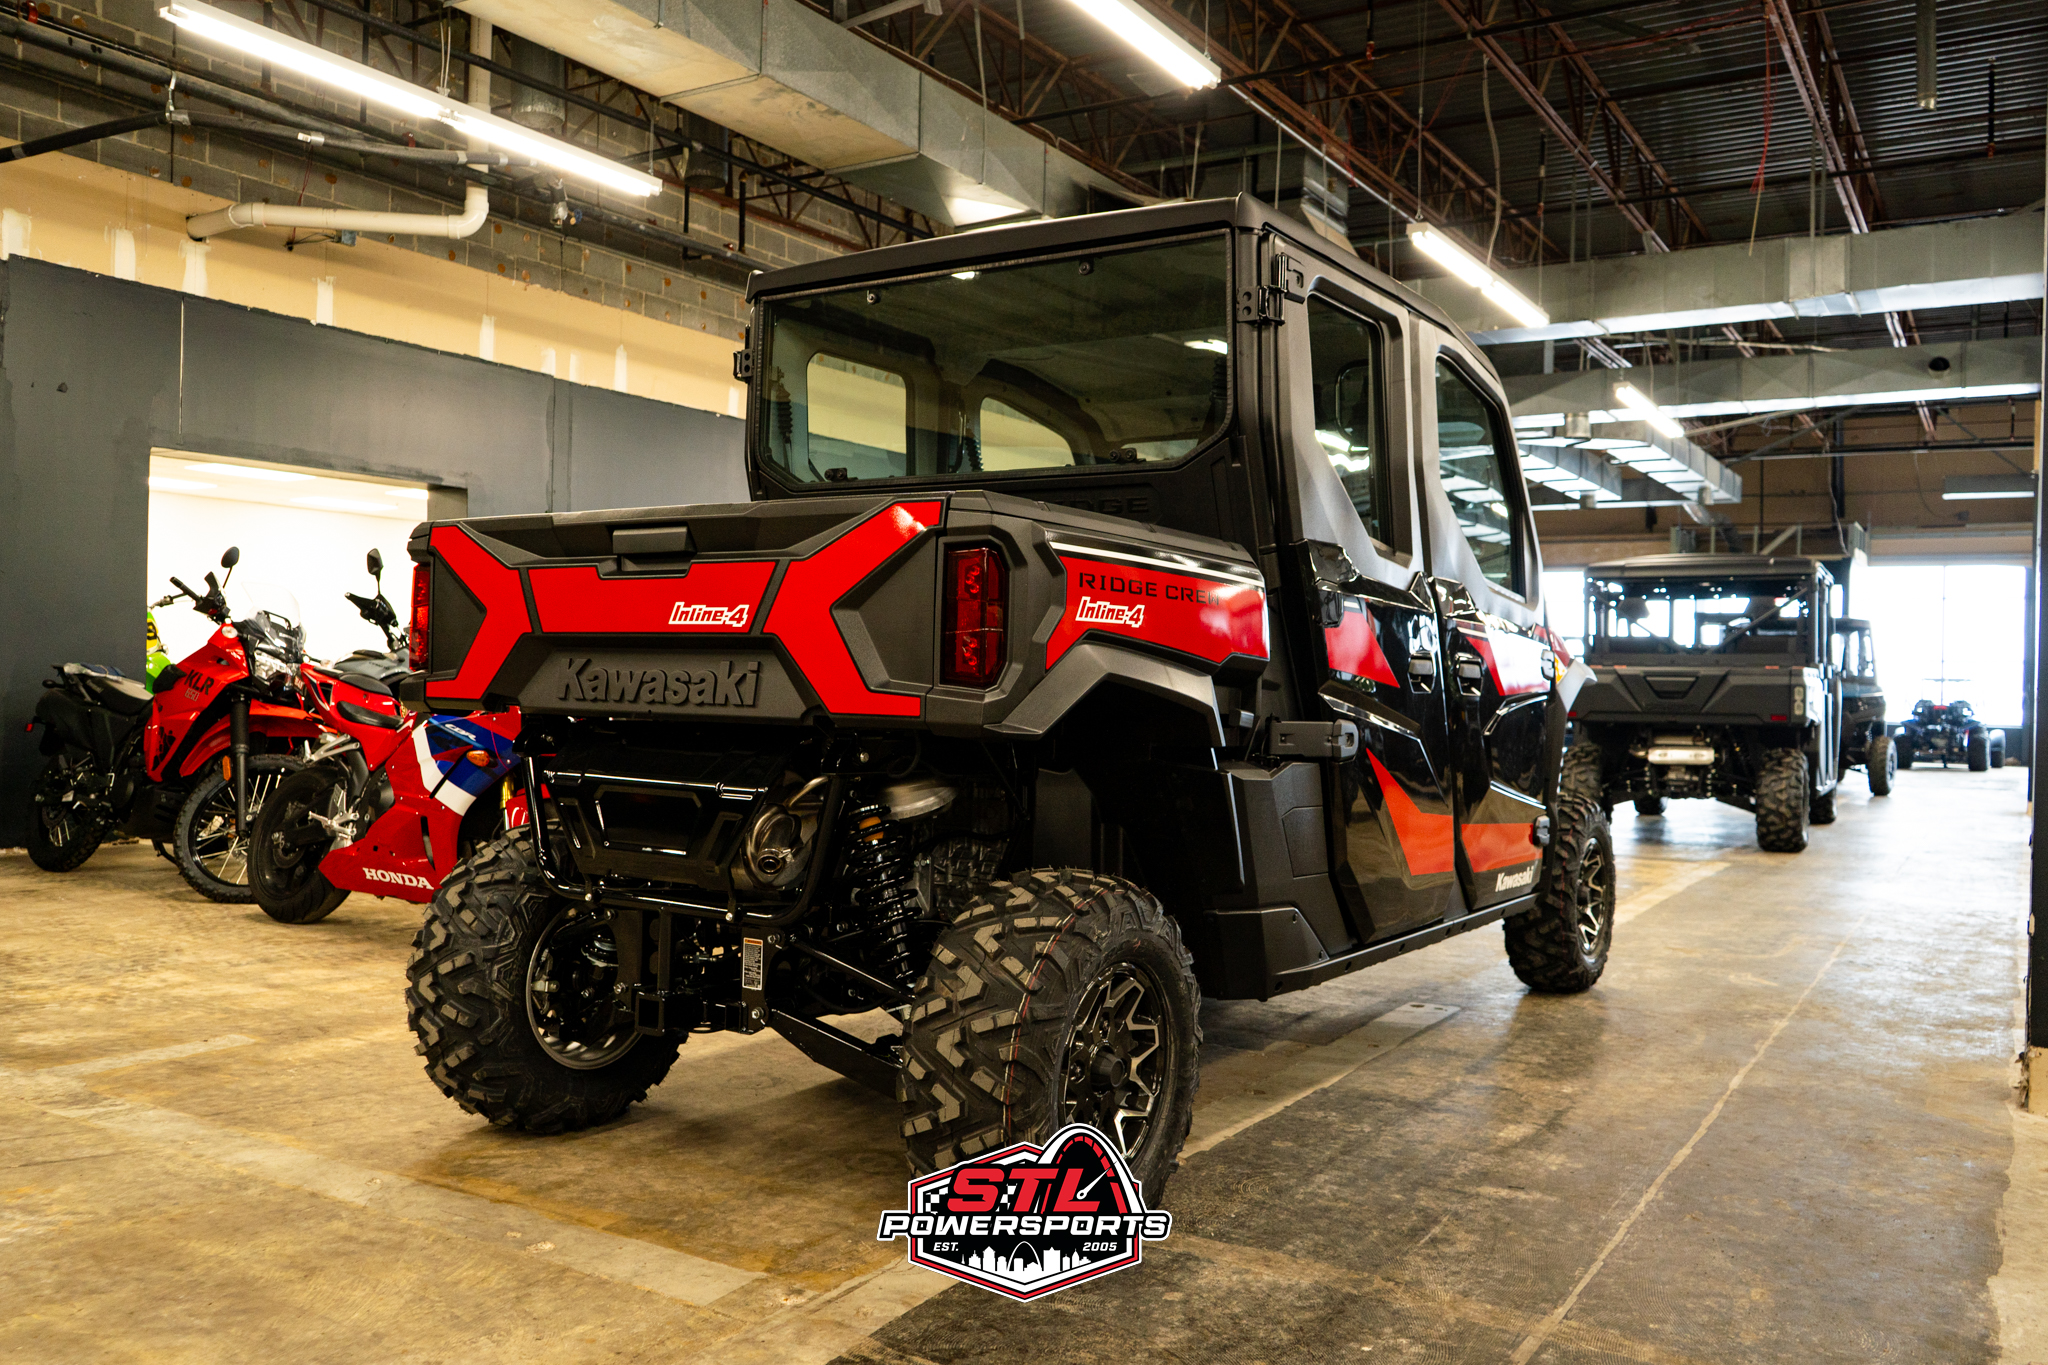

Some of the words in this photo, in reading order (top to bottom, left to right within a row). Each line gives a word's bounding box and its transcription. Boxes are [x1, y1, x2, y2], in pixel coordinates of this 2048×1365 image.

[1079, 572, 1157, 597] RIDGE
[1166, 585, 1220, 606] CREW
[669, 601, 749, 627] Inline-4
[1075, 596, 1145, 628] Inline-4
[184, 669, 215, 695] KLR
[557, 657, 761, 707] Kawasaki
[362, 867, 435, 890] HONDA
[1495, 866, 1534, 893] Kawasaki
